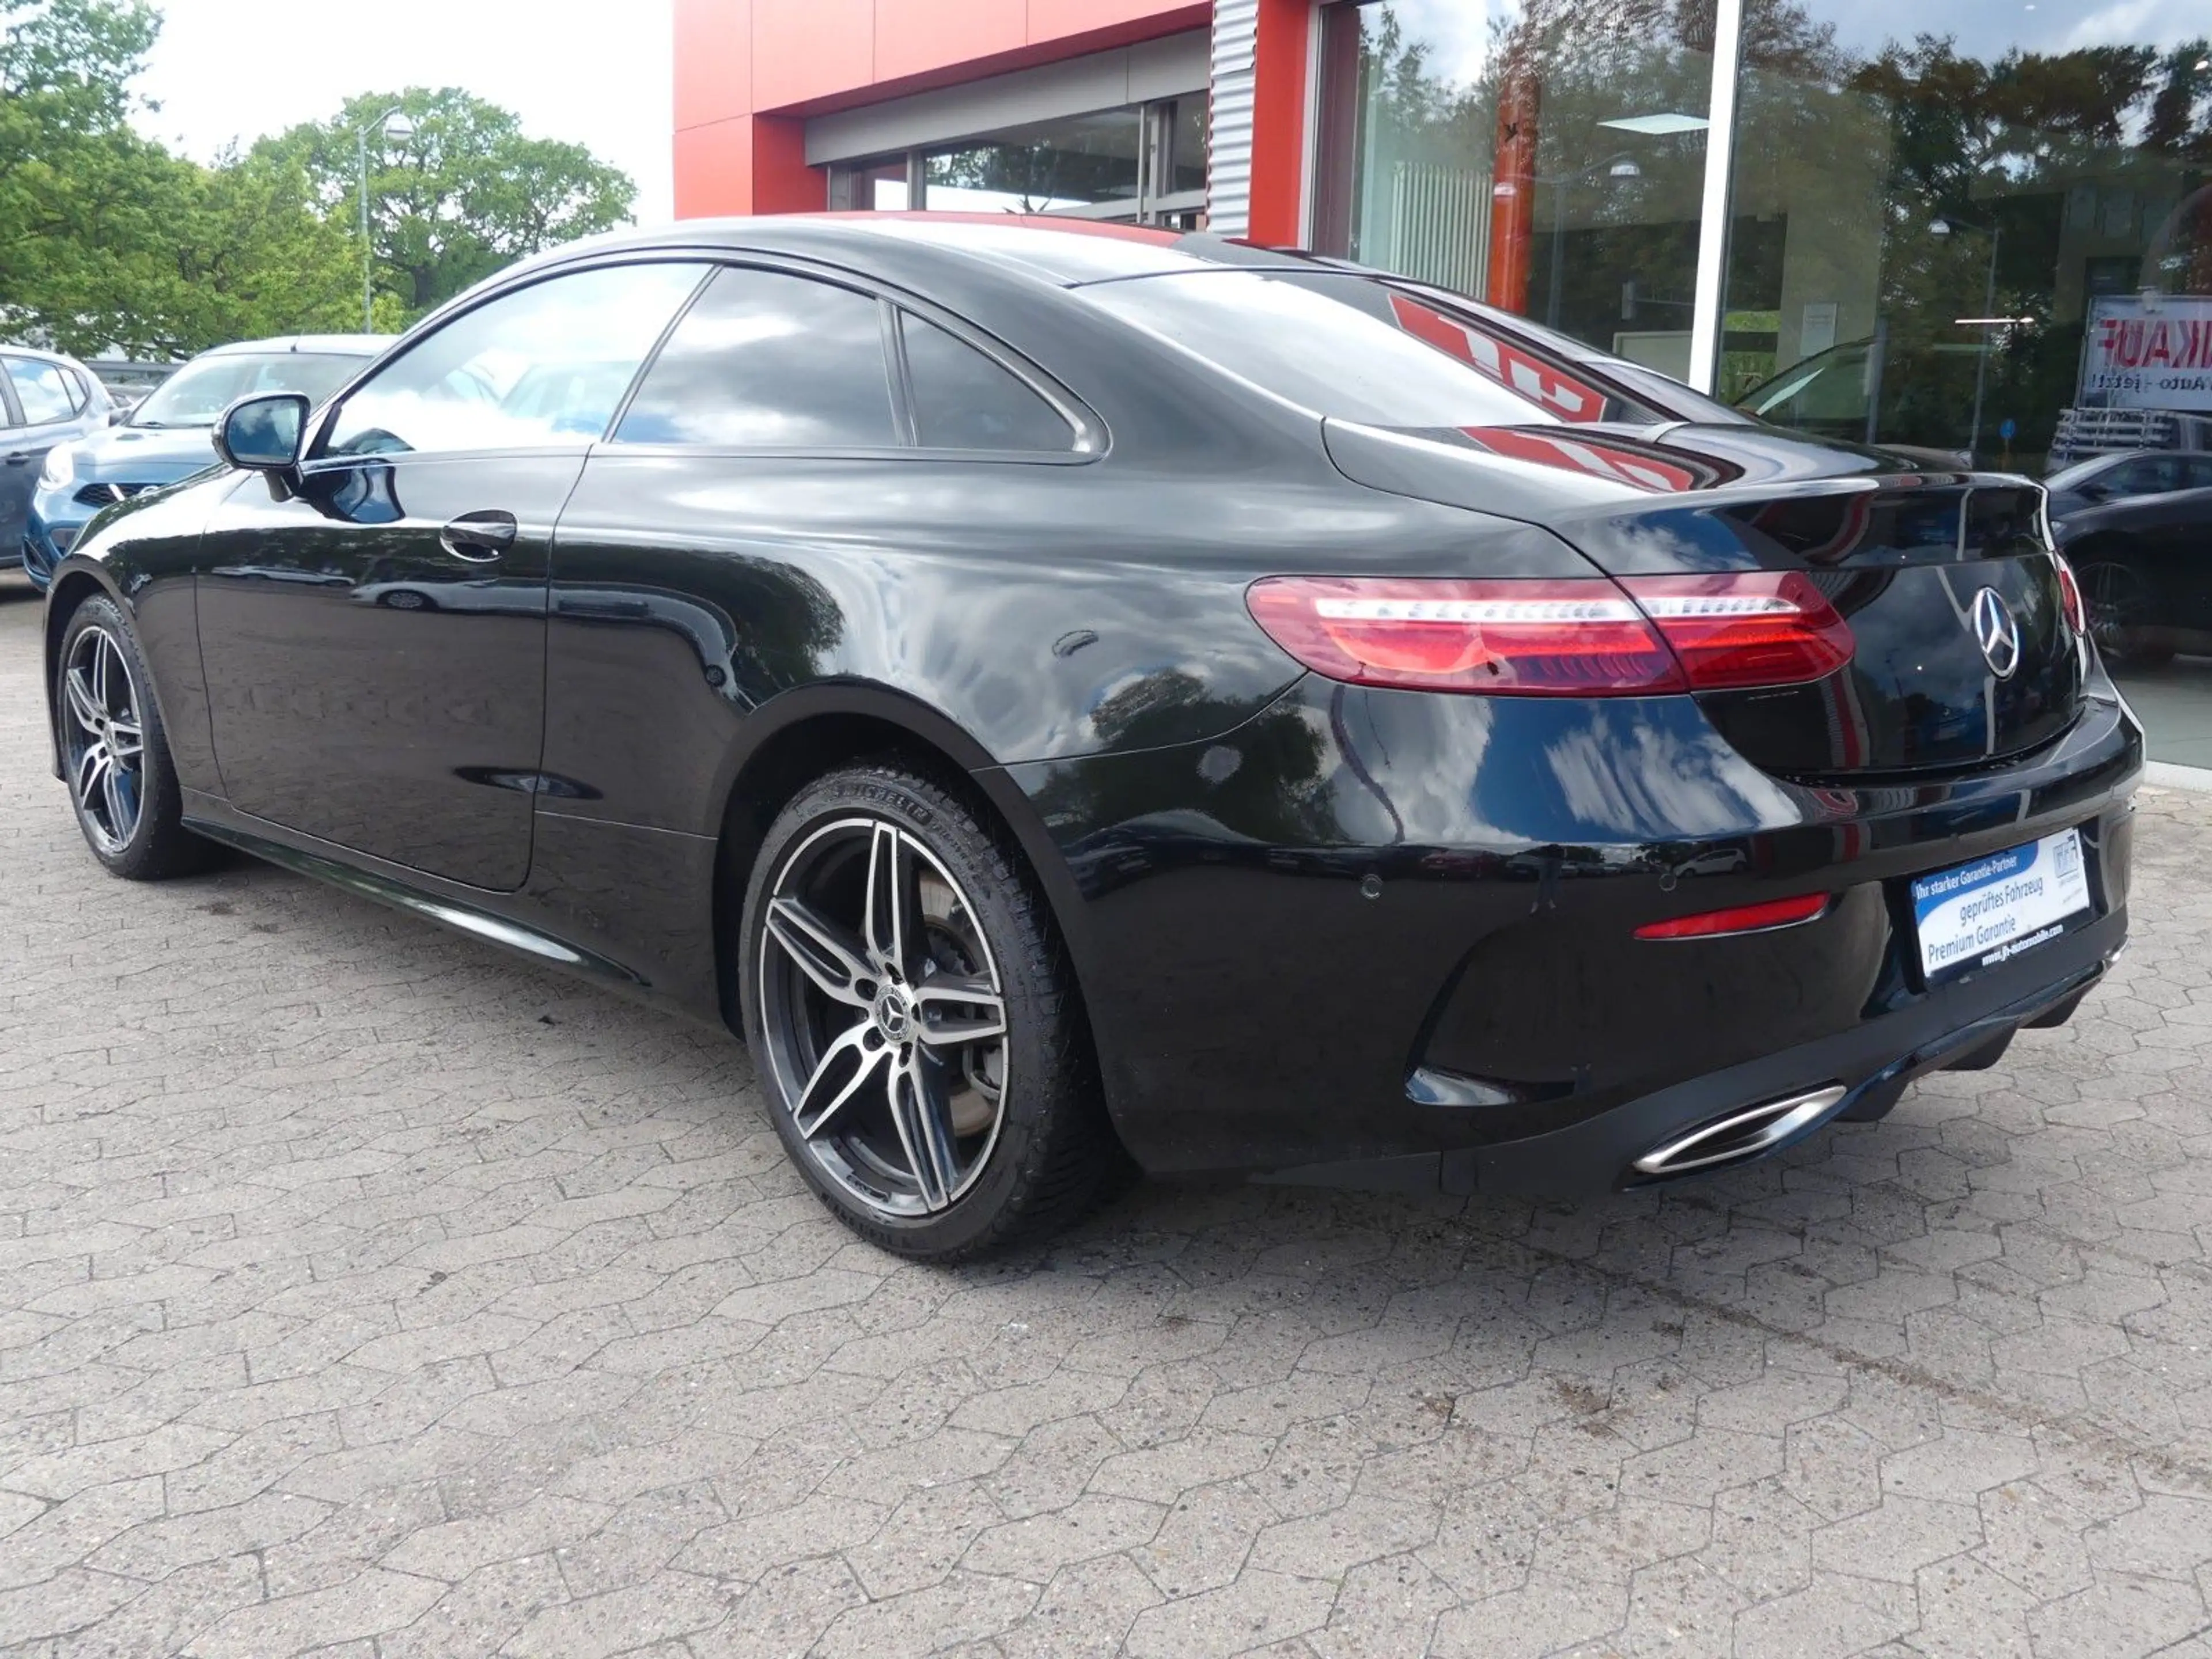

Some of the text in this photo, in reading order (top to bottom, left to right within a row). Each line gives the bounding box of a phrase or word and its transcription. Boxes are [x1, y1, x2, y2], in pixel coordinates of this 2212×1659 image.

[1915, 855, 2018, 899] Ihr starker Garantie-Partner
[1960, 887, 2005, 926] geprüftes
[2005, 875, 2044, 904] Fahrzeug
[1928, 915, 2016, 964] Premium Garantie
